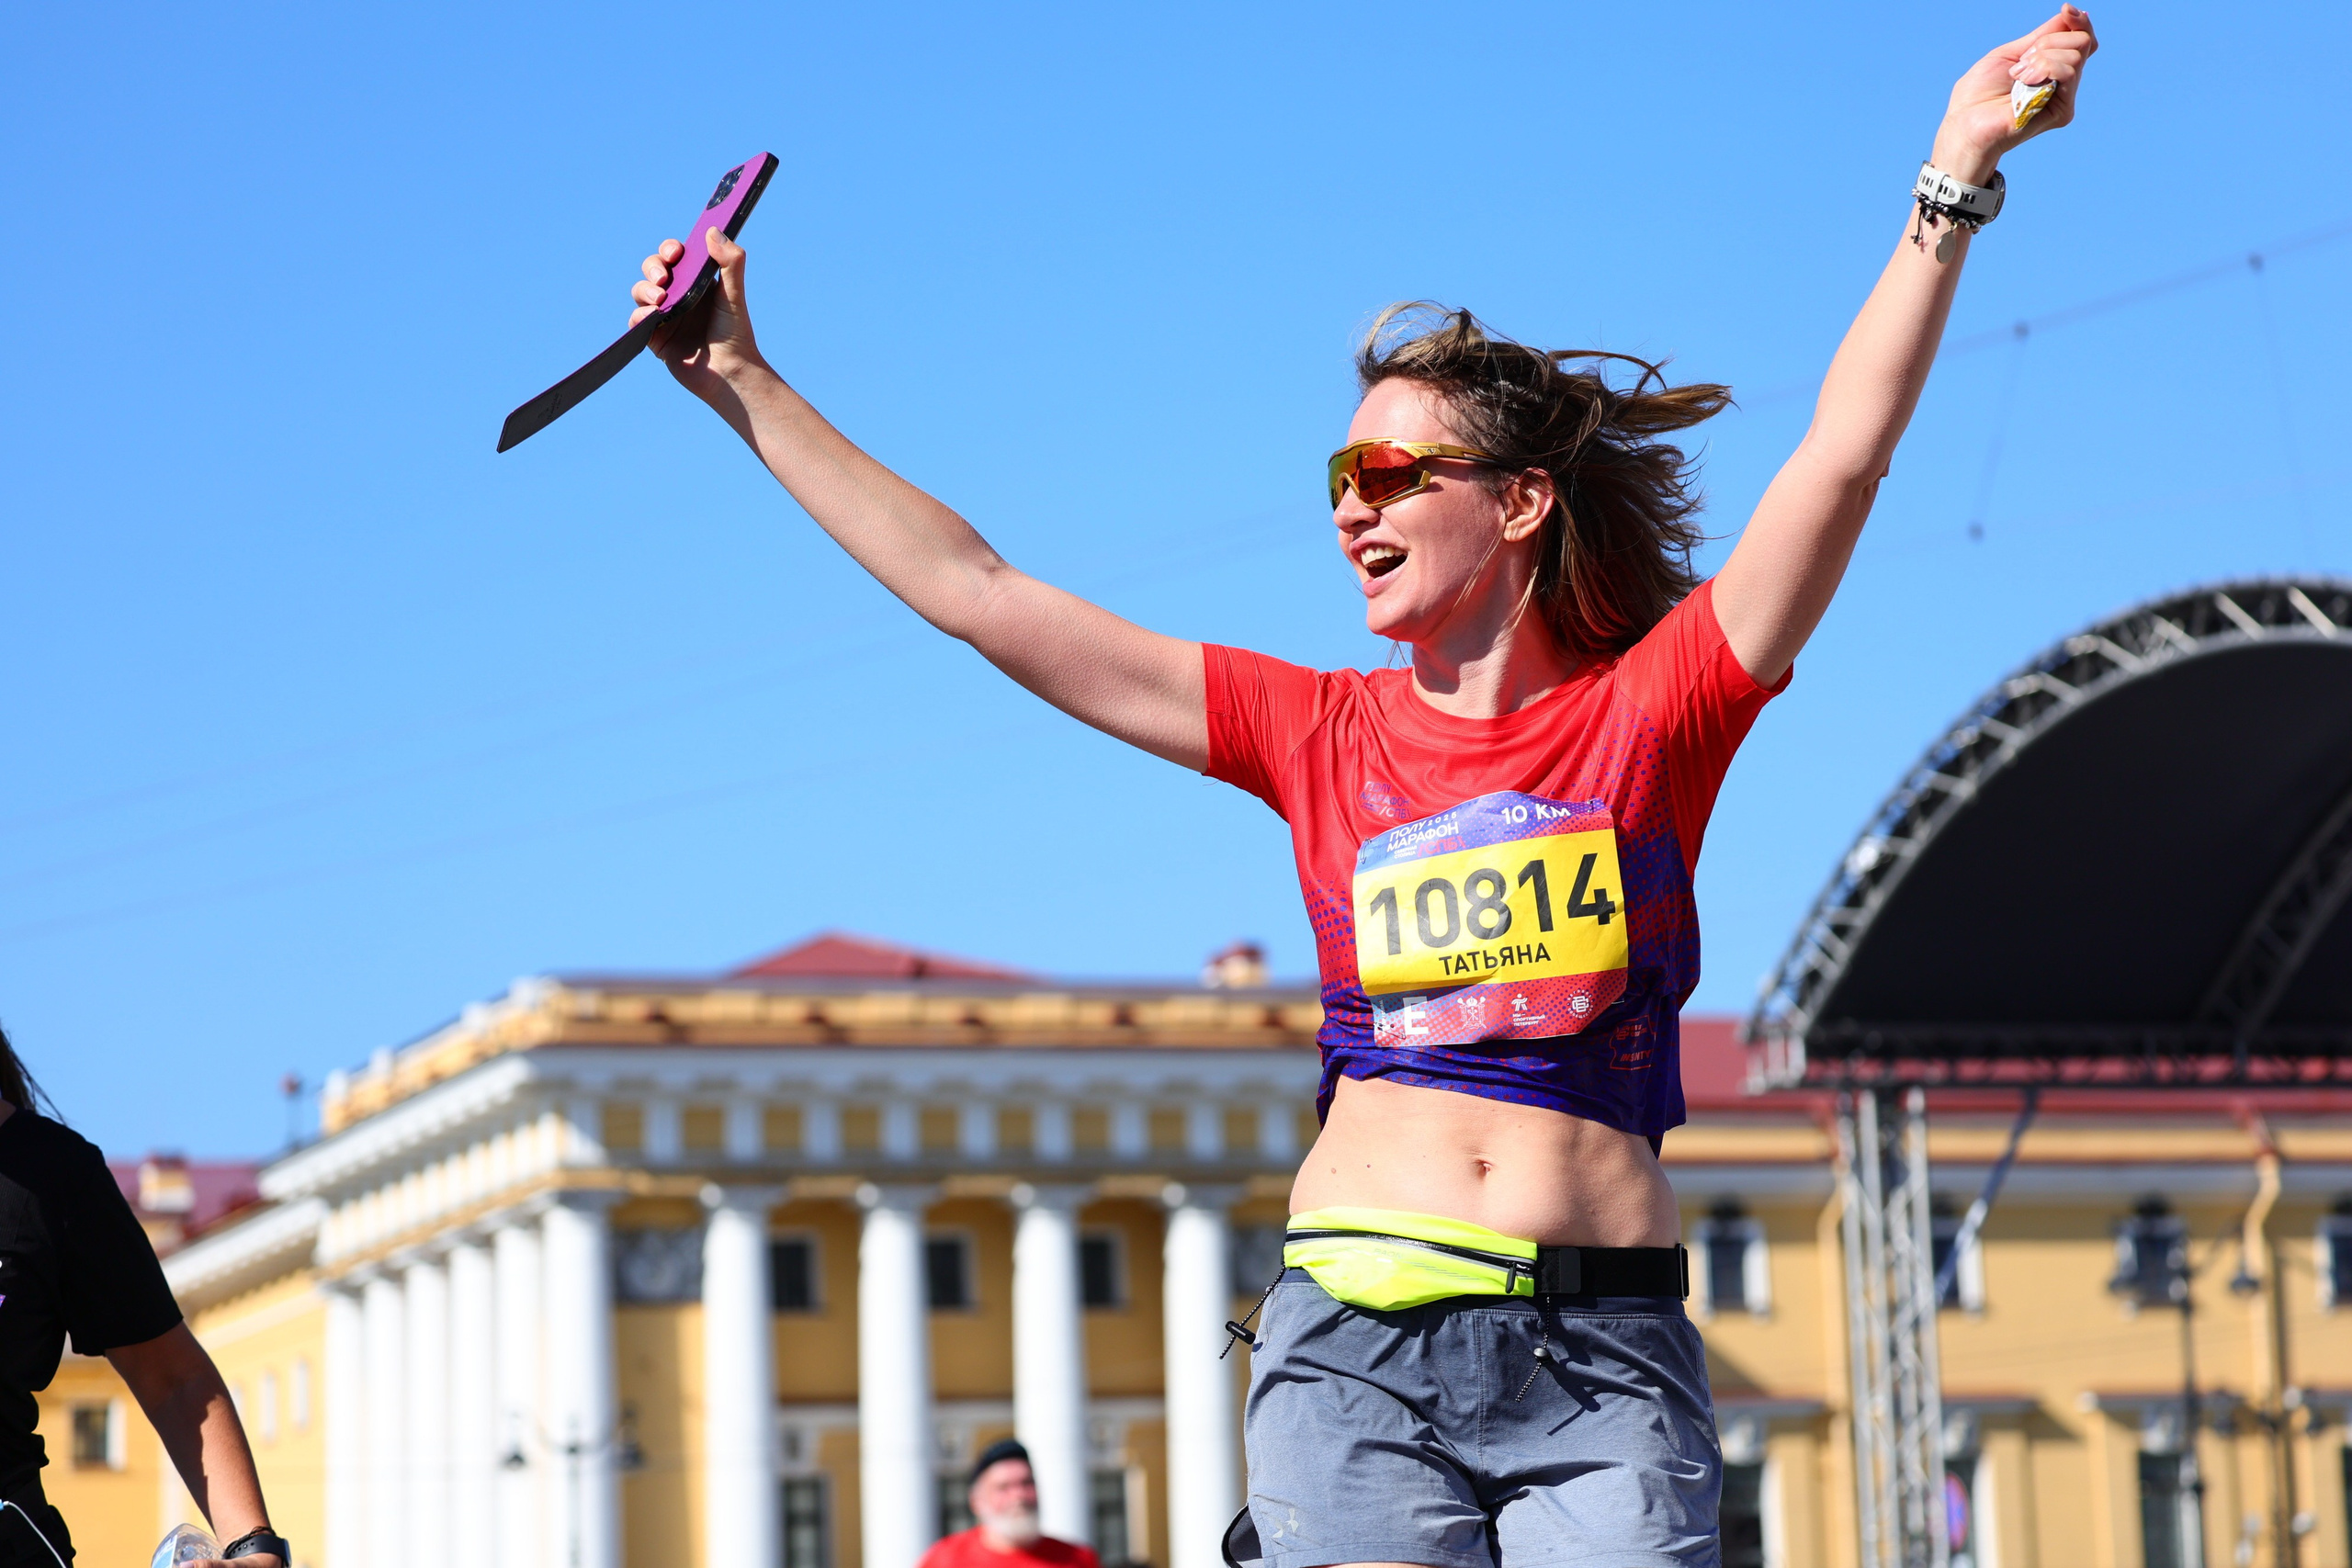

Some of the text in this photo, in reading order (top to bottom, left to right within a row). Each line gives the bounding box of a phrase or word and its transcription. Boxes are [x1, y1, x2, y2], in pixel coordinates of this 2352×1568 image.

[1360, 791, 1410, 807] МАРАФОН
[1363, 781, 1392, 794] ПОЛУ
[1389, 811, 1457, 842] ПОЛУ 2025
[1501, 805, 1528, 825] 10
[1386, 821, 1459, 852] МАРАФОН
[1370, 852, 1616, 955] 10814
[1439, 942, 1551, 976] ТАТЬЯНА
